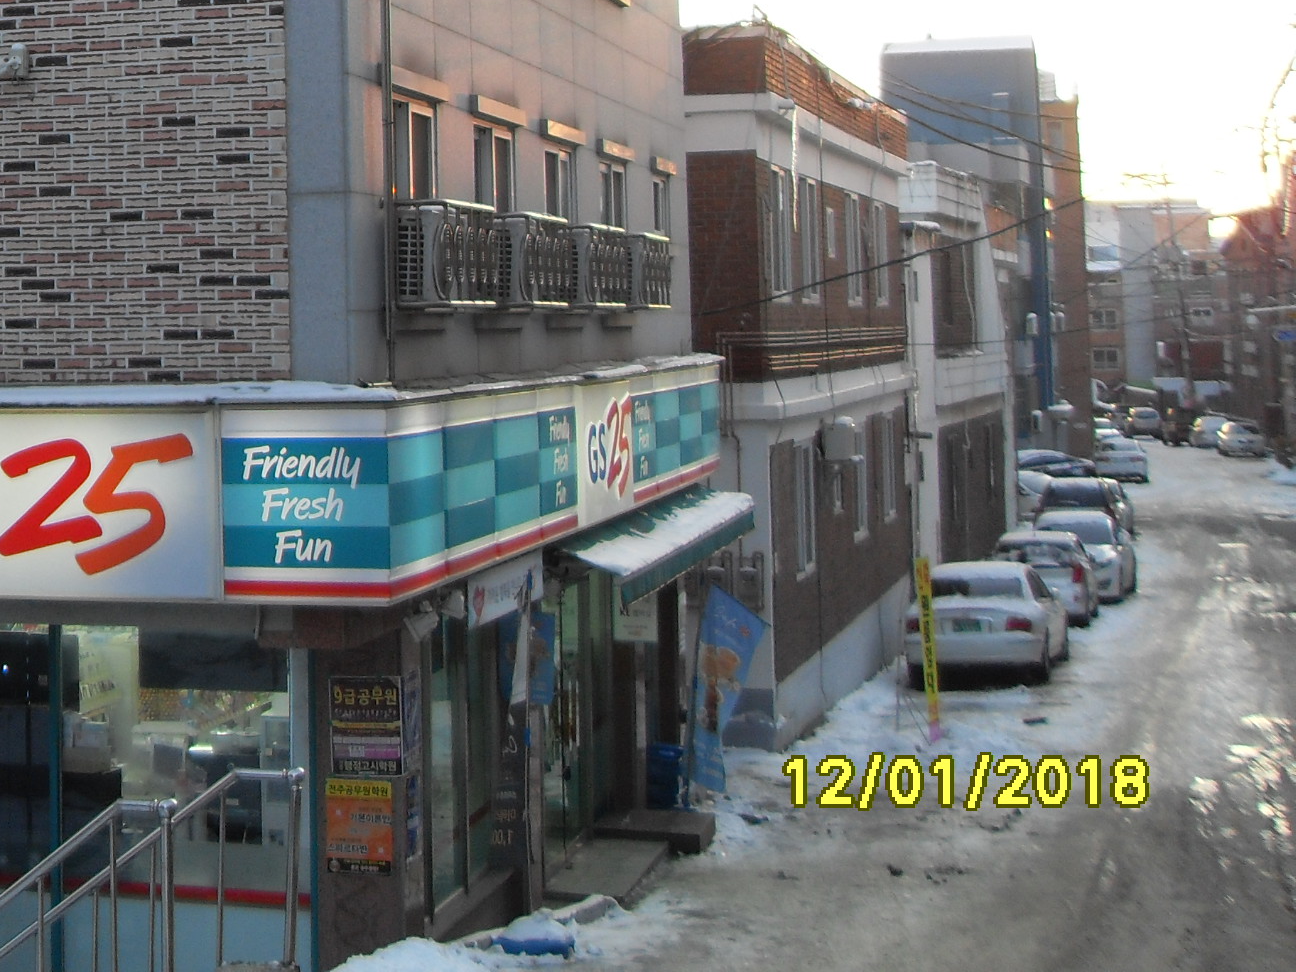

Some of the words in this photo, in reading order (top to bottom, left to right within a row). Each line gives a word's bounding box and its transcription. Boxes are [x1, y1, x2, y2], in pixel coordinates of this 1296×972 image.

[242, 446, 361, 489] Friendly
[261, 489, 344, 522] Fresh
[274, 529, 333, 564] Fun
